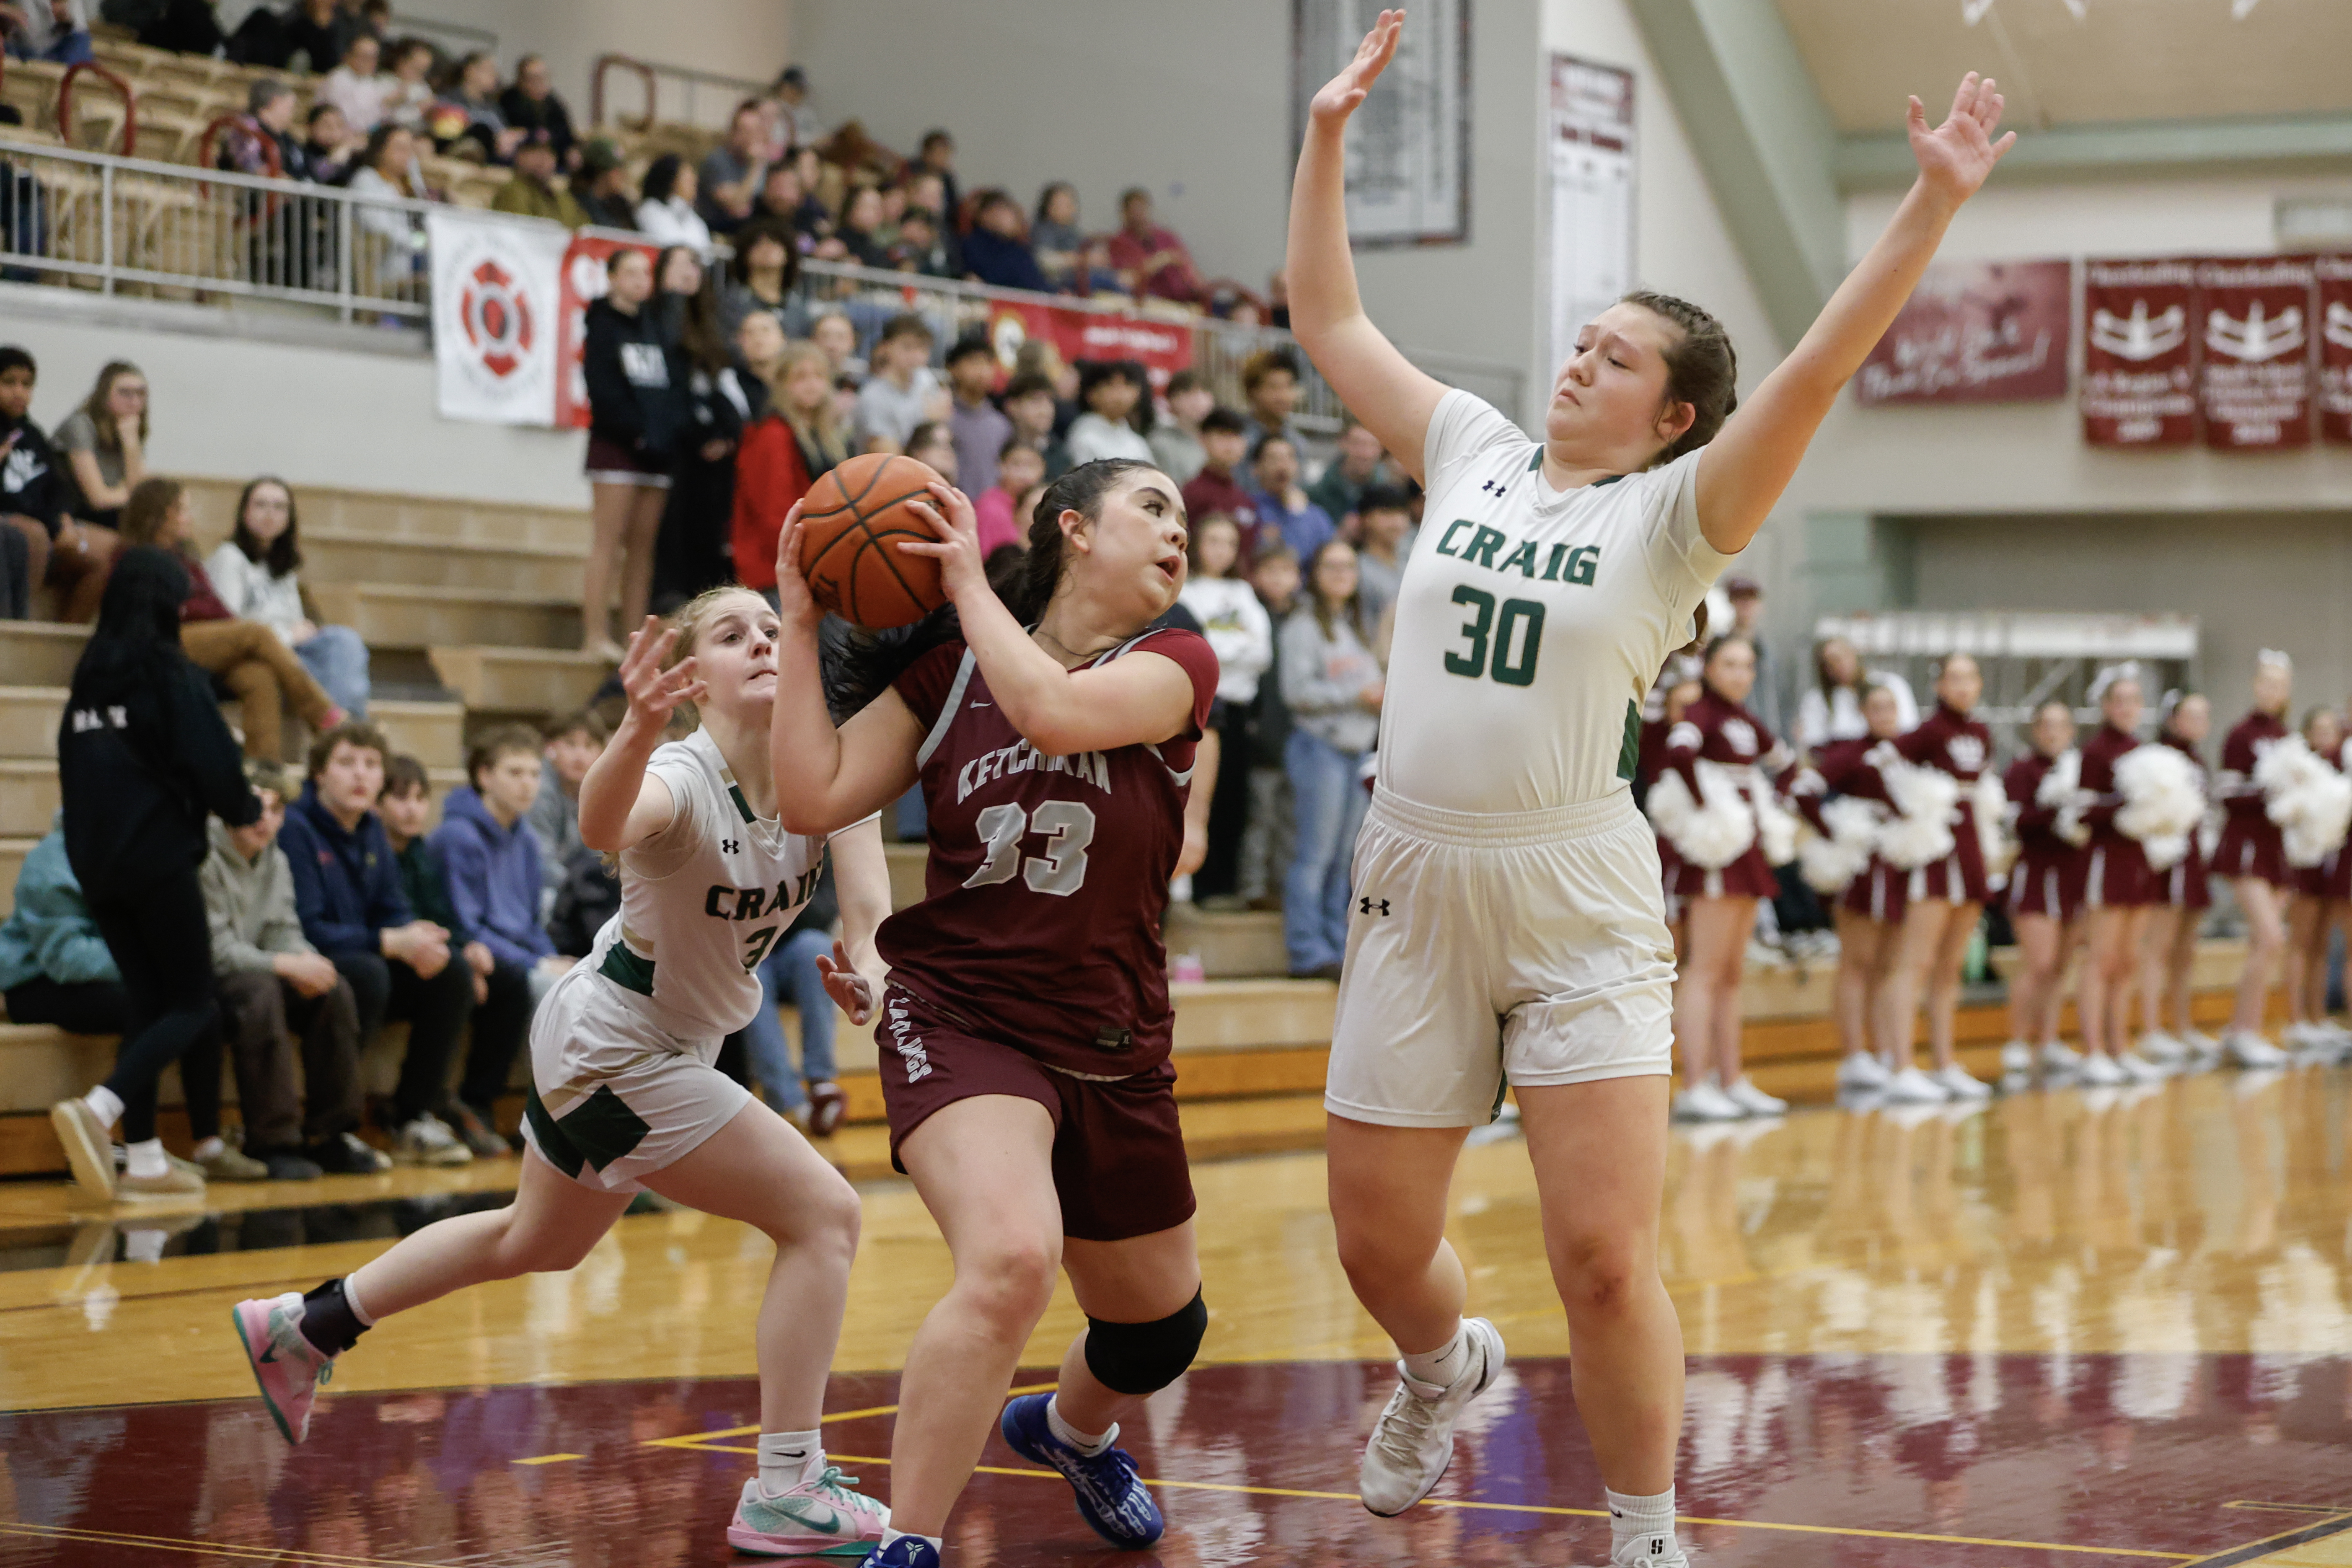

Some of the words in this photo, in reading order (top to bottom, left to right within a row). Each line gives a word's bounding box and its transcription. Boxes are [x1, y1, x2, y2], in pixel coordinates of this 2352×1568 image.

[1436, 519, 1600, 587] CRAIG
[1444, 584, 1547, 687] 30
[962, 800, 1096, 897] 33
